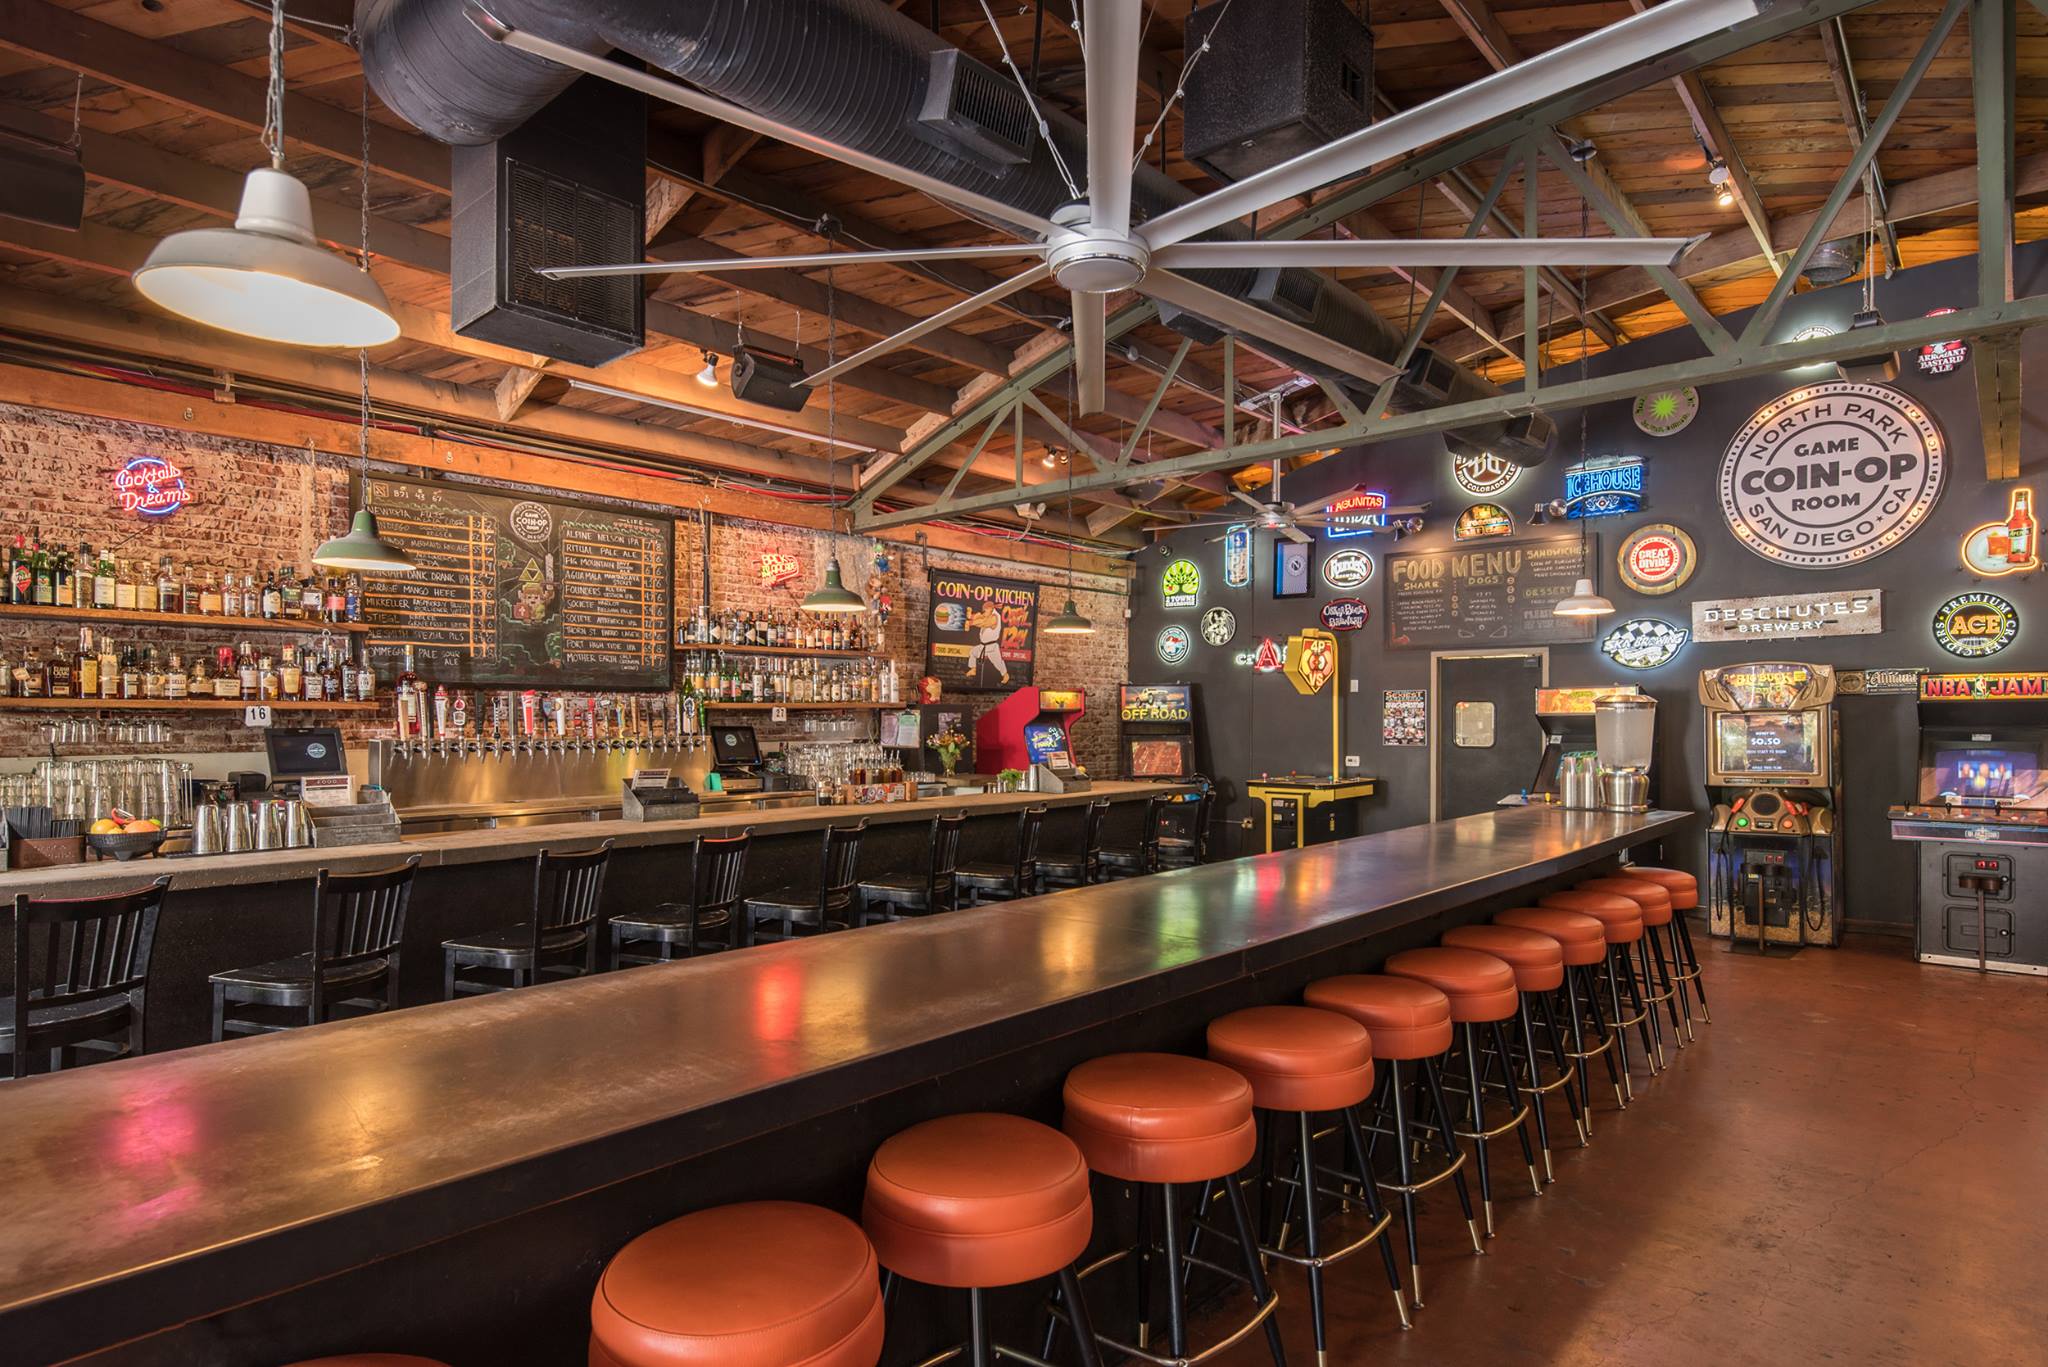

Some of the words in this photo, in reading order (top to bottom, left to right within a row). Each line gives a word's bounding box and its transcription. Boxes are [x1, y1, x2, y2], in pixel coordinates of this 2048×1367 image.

[1919, 355, 1964, 370] BASTARD
[1930, 365, 1953, 375] ALE
[1750, 403, 1832, 460] NORTH
[1843, 402, 1909, 445] PARK
[1794, 437, 1859, 458] GAME
[115, 461, 181, 492] Cocktails
[1567, 464, 1642, 500] ICEHOUSE
[1741, 453, 1917, 496] COIN-OP
[1467, 479, 1506, 493] COLORADO
[119, 490, 191, 511] Dreams
[1791, 492, 1860, 512] ROOM
[1749, 503, 1789, 540] SAN
[1793, 520, 1875, 547] DIEGO
[1881, 486, 1912, 516] CA
[566, 529, 592, 541] ALPINE
[597, 533, 625, 544] NELSON
[627, 537, 640, 546] IPA
[1638, 547, 1670, 560] GREAT
[1392, 558, 1445, 583] FOOD
[1451, 549, 1522, 577] MENU
[1638, 557, 1671, 569] DIVIDE
[406, 570, 429, 581] DANK
[431, 572, 456, 583] DRANK
[1468, 576, 1498, 585] DOGS
[403, 584, 430, 598] MANGO
[565, 585, 601, 597] FOUNDERS
[936, 580, 993, 602] COIN-OP
[994, 587, 1035, 606] KITCHEN
[1403, 580, 1440, 591] SHARE
[366, 597, 410, 609] MIKKELLER
[1942, 594, 2012, 615] PREMIUM
[1704, 600, 1869, 623] DESCHUTES
[1738, 620, 1824, 634] BREWERY
[1950, 615, 2001, 635] ACE
[1633, 632, 1684, 649] BREWING
[1935, 621, 1973, 657] CIDERS
[1985, 619, 2017, 655] CRAFT
[368, 646, 408, 658] OMMEGAN
[418, 648, 438, 659] PALE
[1310, 640, 1326, 653] 4P
[566, 653, 597, 664] MOTHER
[598, 654, 617, 664] EARTH
[1308, 672, 1324, 687] VS
[1759, 672, 1791, 684] BUCK
[1926, 679, 1970, 697] NBA
[1988, 677, 2043, 696] JAM
[250, 707, 266, 721] 16
[1121, 707, 1148, 720] OFF
[1151, 707, 1187, 720] ROAD
